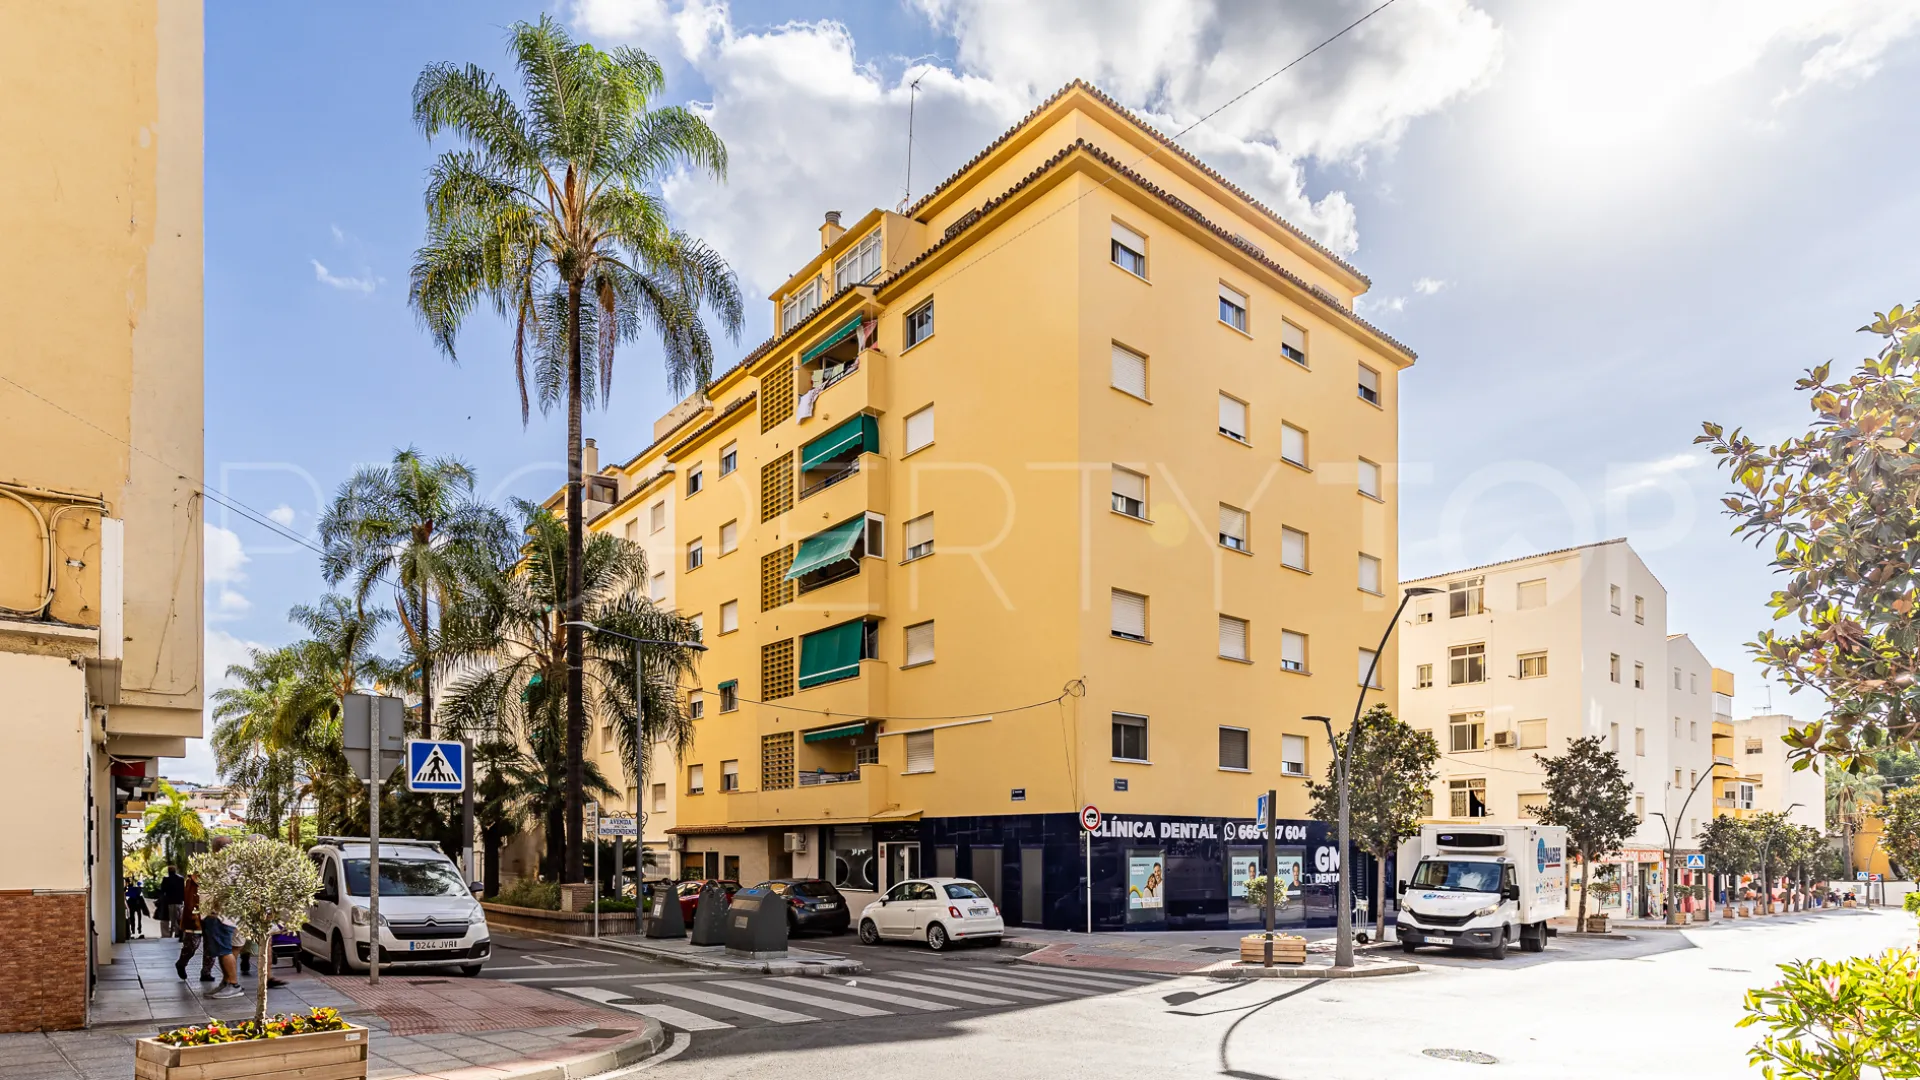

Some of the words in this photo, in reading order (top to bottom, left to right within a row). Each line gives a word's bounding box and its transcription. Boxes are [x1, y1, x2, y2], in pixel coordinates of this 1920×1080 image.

[1160, 822, 1217, 839] DENTAL
[1238, 824, 1261, 840] 669
[1285, 825, 1307, 840] 604
[1315, 873, 1340, 884] DENTA
